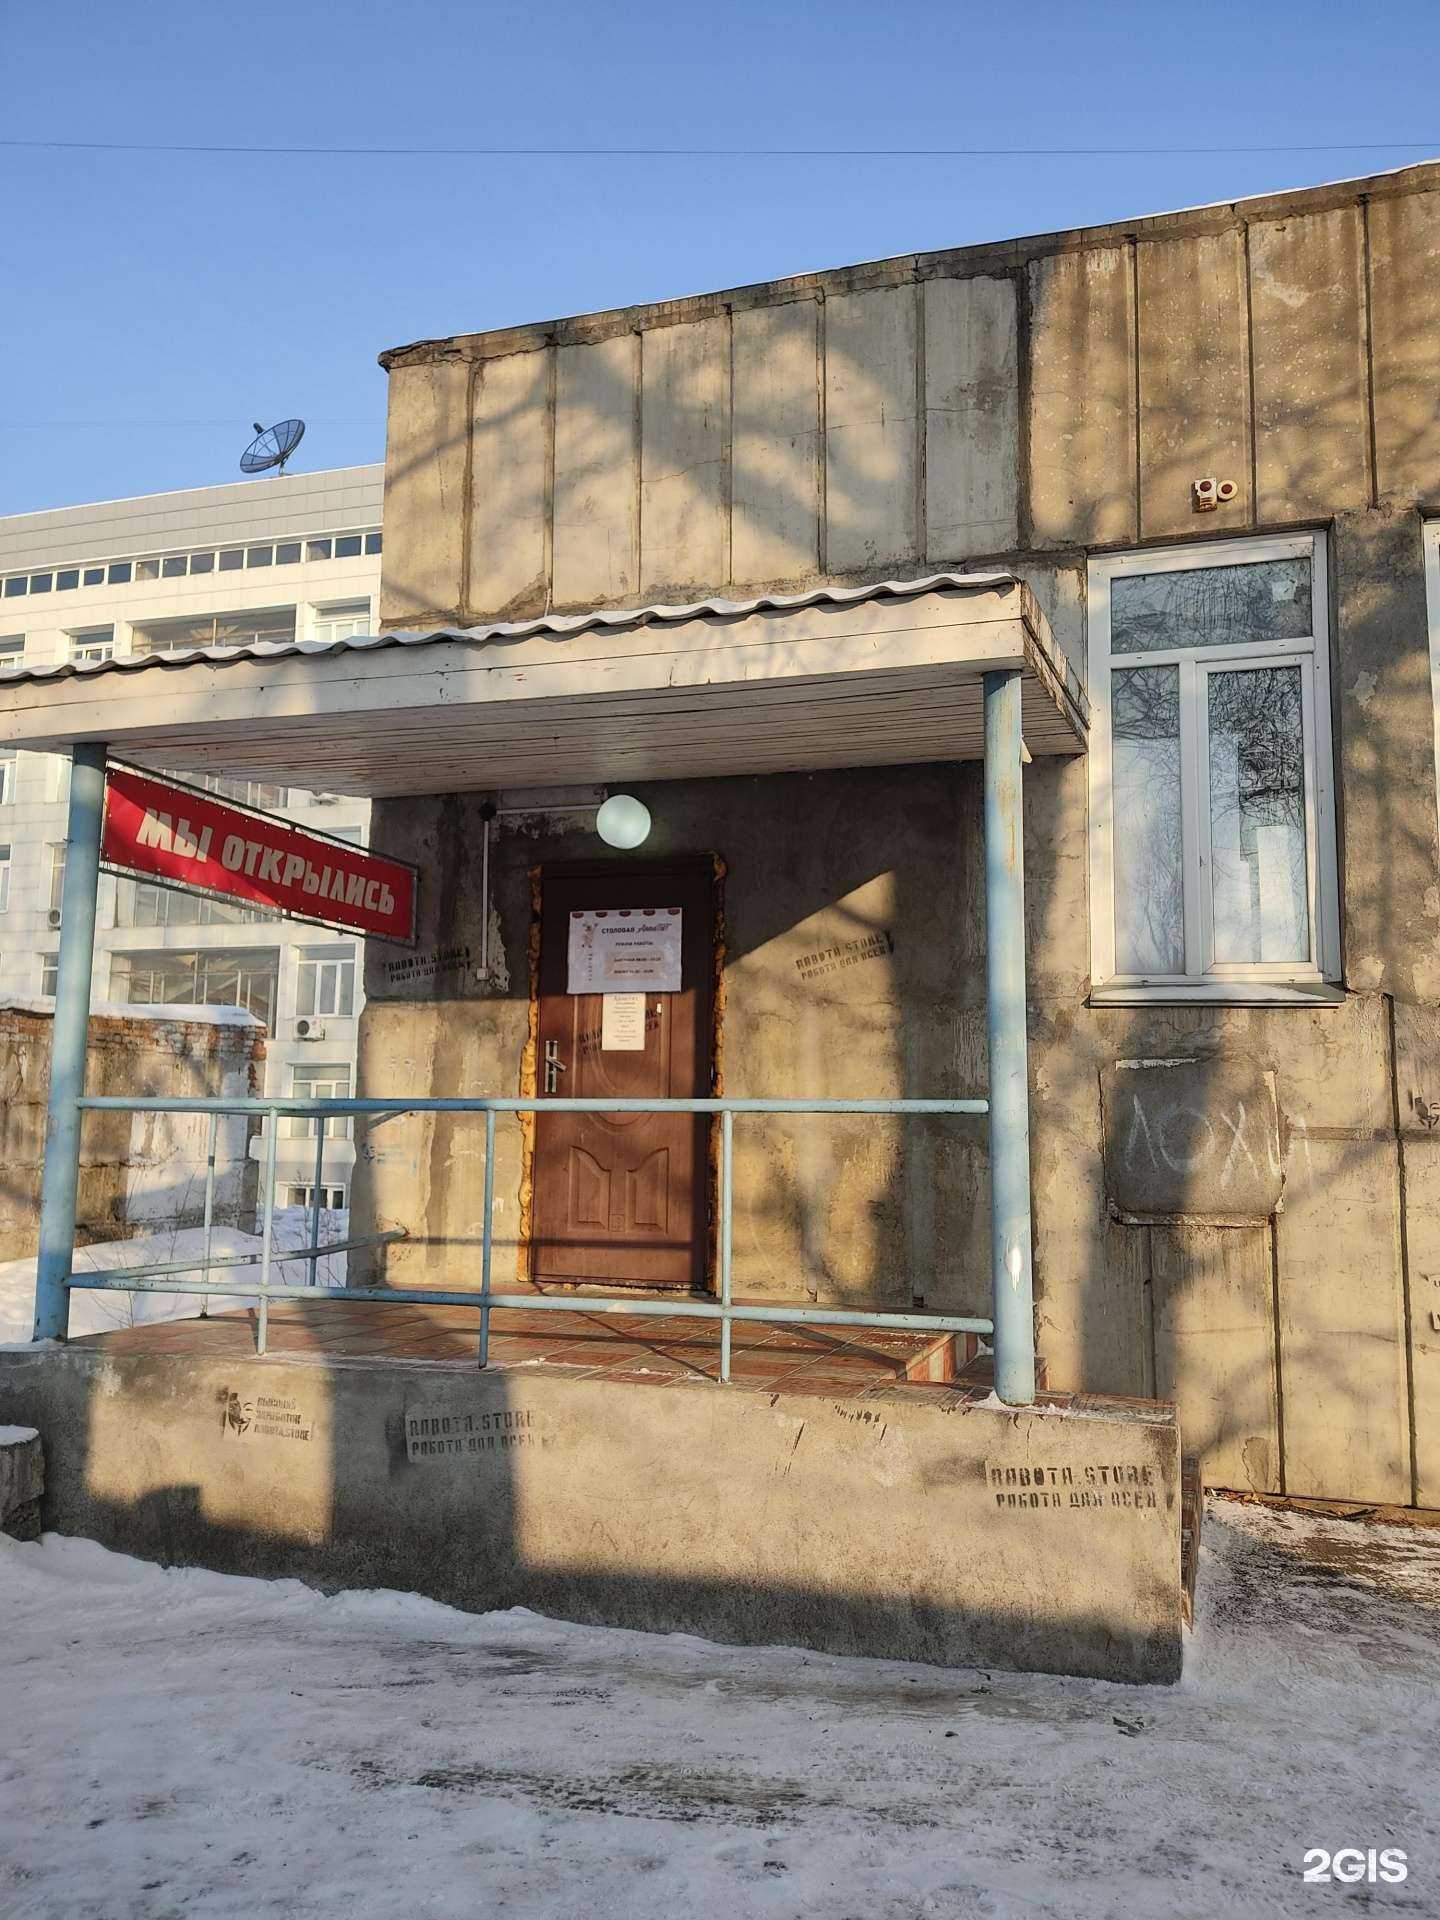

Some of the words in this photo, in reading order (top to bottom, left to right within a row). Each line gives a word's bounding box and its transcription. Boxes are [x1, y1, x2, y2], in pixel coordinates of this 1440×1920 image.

[136, 808, 213, 864] МЫ
[221, 834, 395, 916] ОТКРЫЛИСЬ
[409, 1409, 534, 1437] RABOTA.STORE
[411, 1439, 463, 1456] РАБОТА
[991, 1465, 1154, 1487] RABOTA.STORE
[996, 1492, 1062, 1508] РАБОТА
